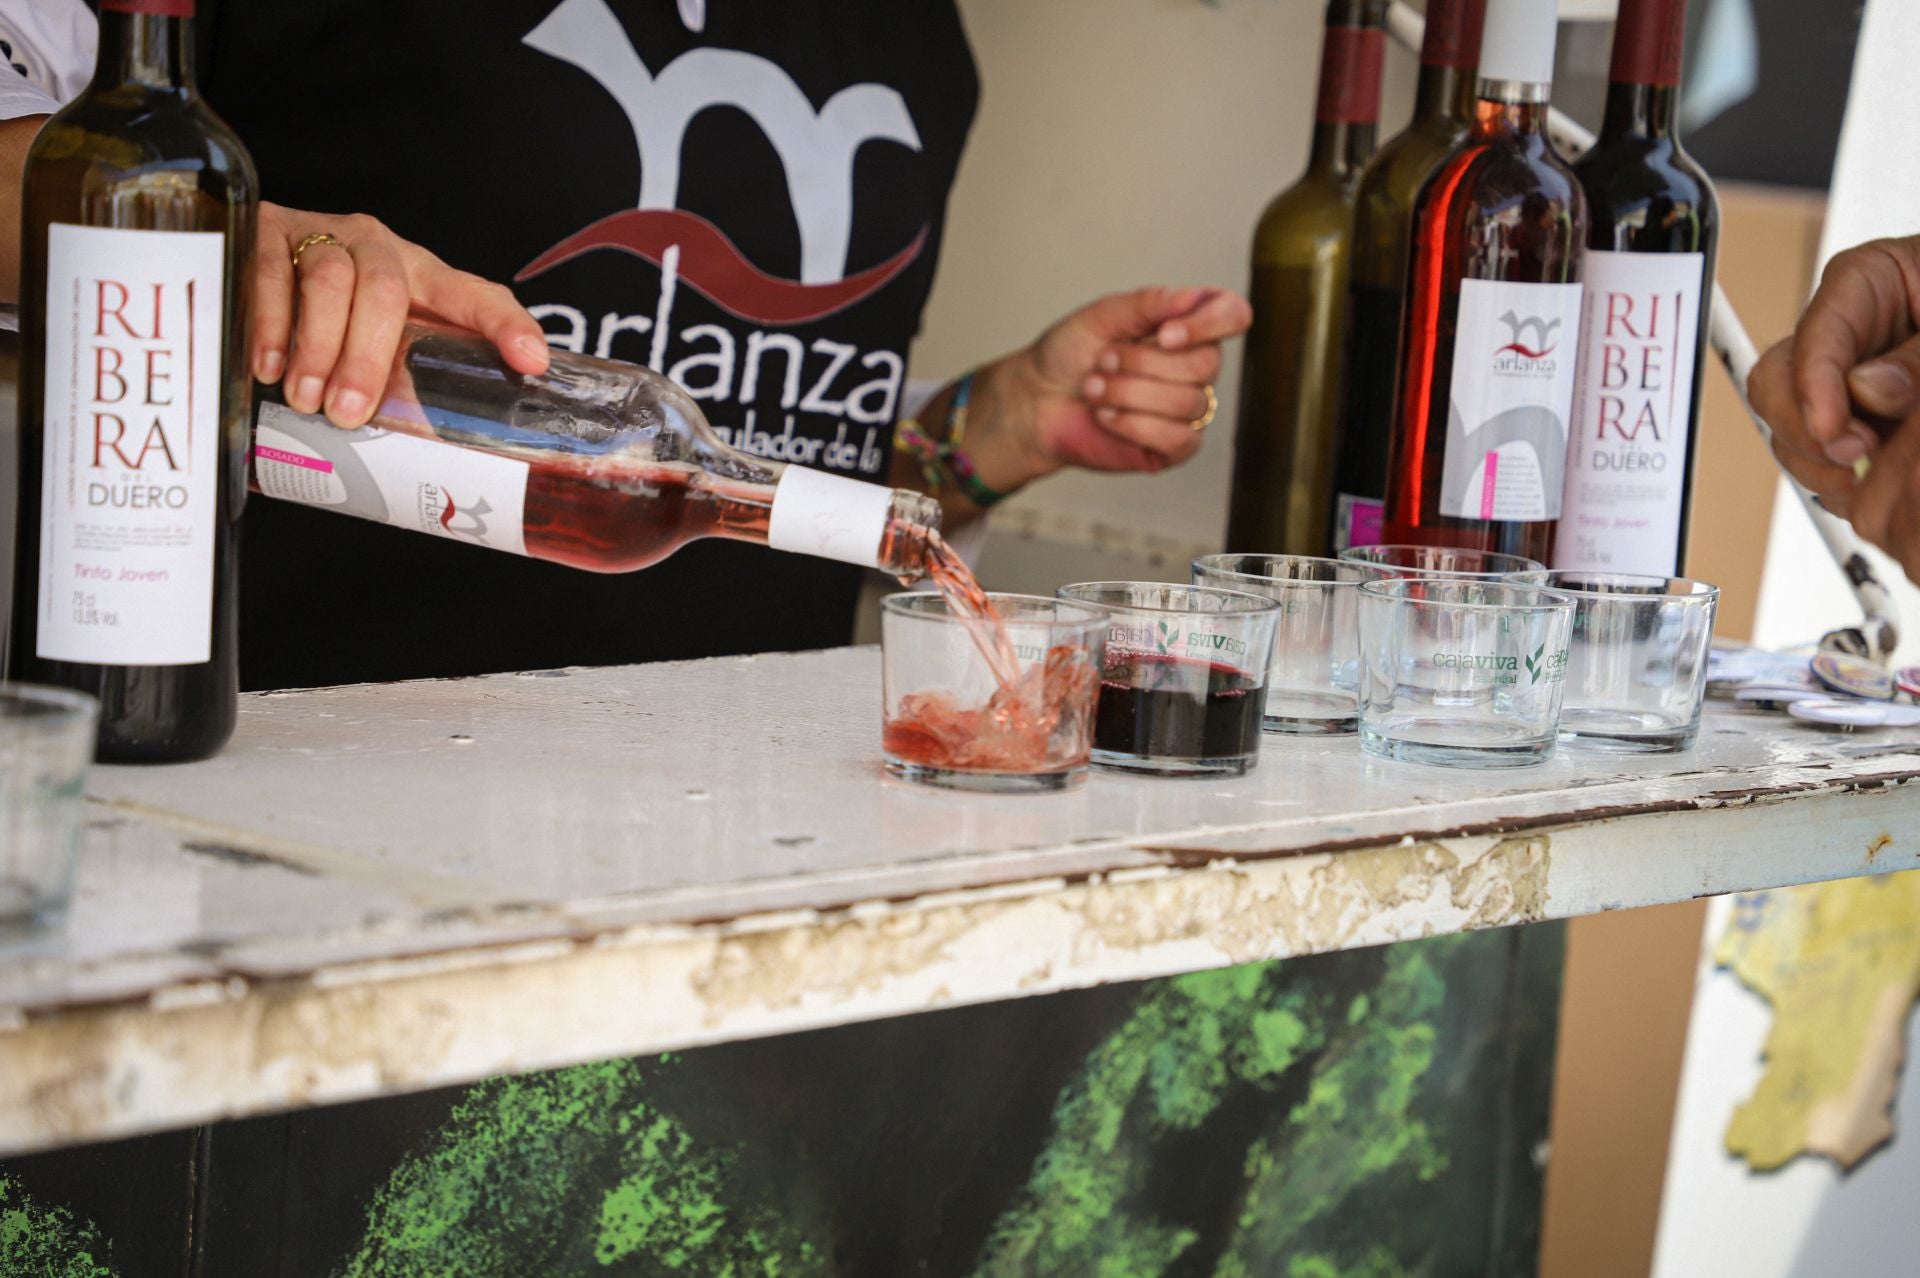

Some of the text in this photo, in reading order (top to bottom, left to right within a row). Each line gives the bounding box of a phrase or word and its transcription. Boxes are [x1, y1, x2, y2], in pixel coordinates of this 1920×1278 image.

[527, 244, 904, 425] arlanza
[1493, 350, 1556, 372] arlanza
[260, 447, 305, 465] ROSADO
[1592, 450, 1667, 473] DUERO
[87, 482, 190, 510] DUERO
[74, 563, 112, 581] Tinto
[1433, 651, 1518, 673] cajaviva
